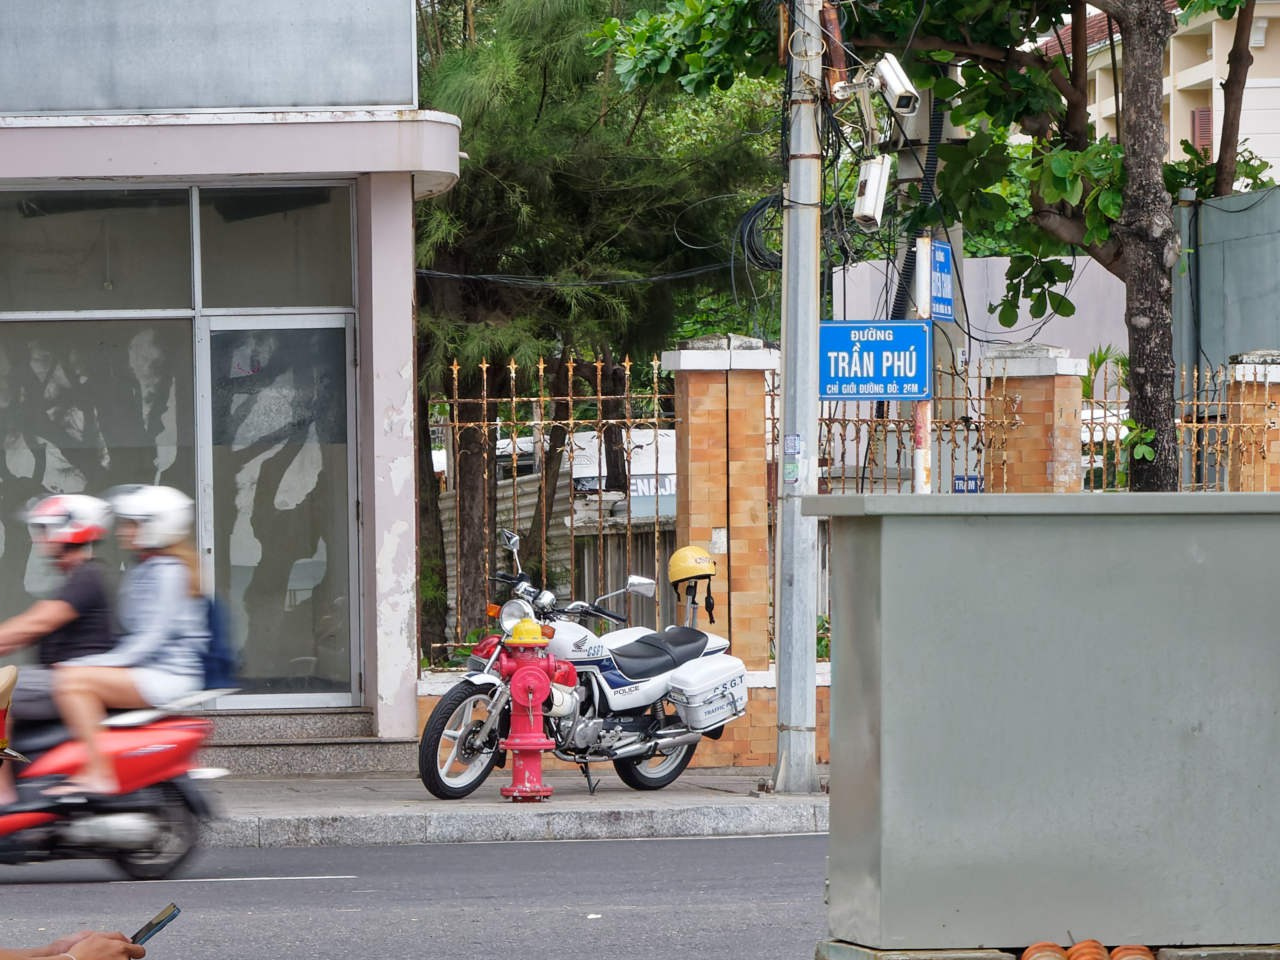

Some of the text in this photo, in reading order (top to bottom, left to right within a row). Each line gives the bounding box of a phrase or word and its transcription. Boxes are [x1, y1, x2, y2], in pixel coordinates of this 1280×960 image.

[850, 328, 894, 341] ĐƯỜNG
[827, 342, 917, 378] TRẦN PHÚ
[859, 382, 885, 394] ĐƯỜNG
[614, 685, 640, 696] POLICE
